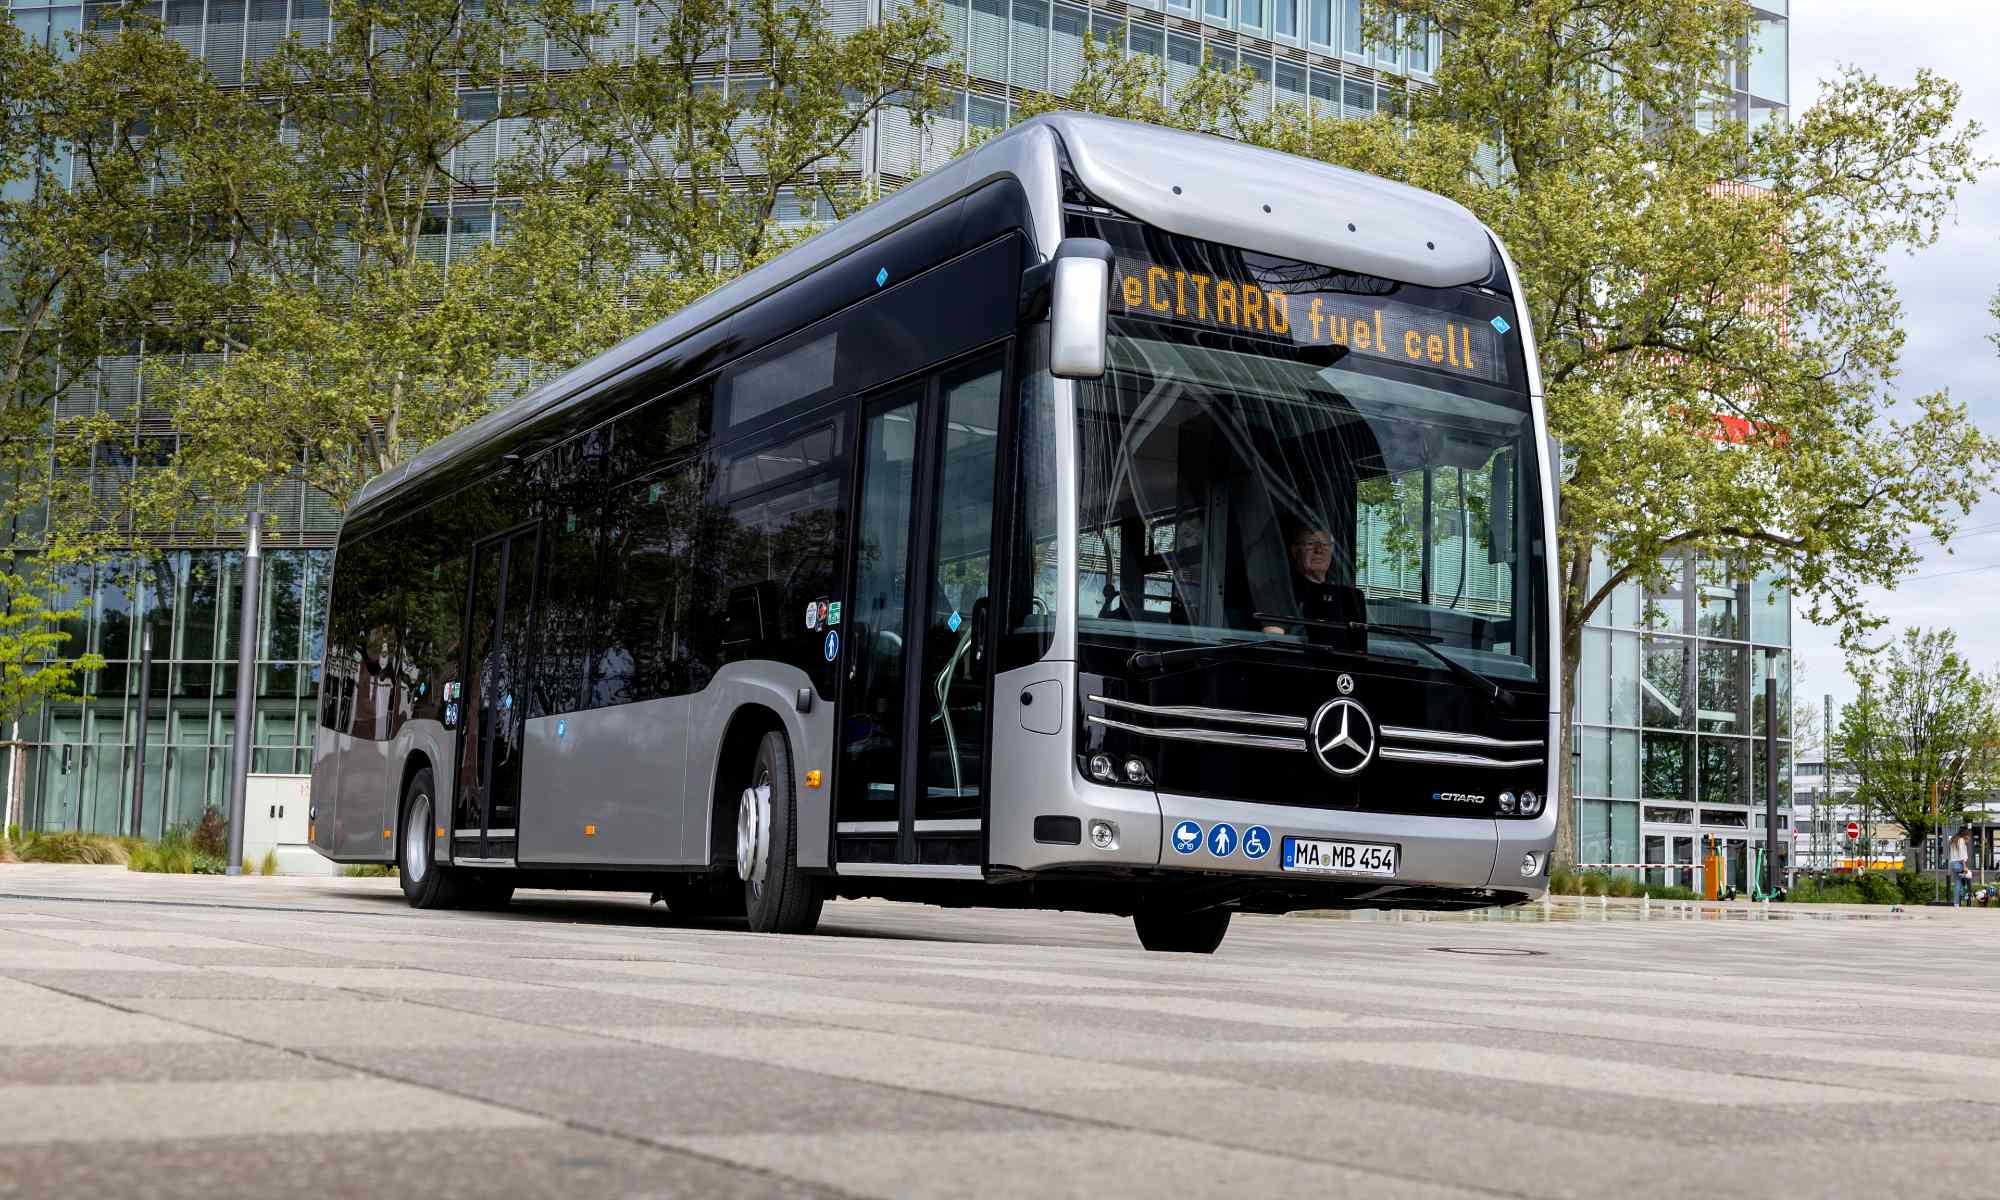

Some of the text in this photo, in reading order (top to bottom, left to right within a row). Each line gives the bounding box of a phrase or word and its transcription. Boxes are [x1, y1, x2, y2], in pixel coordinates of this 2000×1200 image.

[1308, 297, 1386, 353] fuel
[1404, 320, 1473, 369] cell
[1432, 792, 1485, 804] eCITARO
[1295, 843, 1392, 870] MA MB 454
